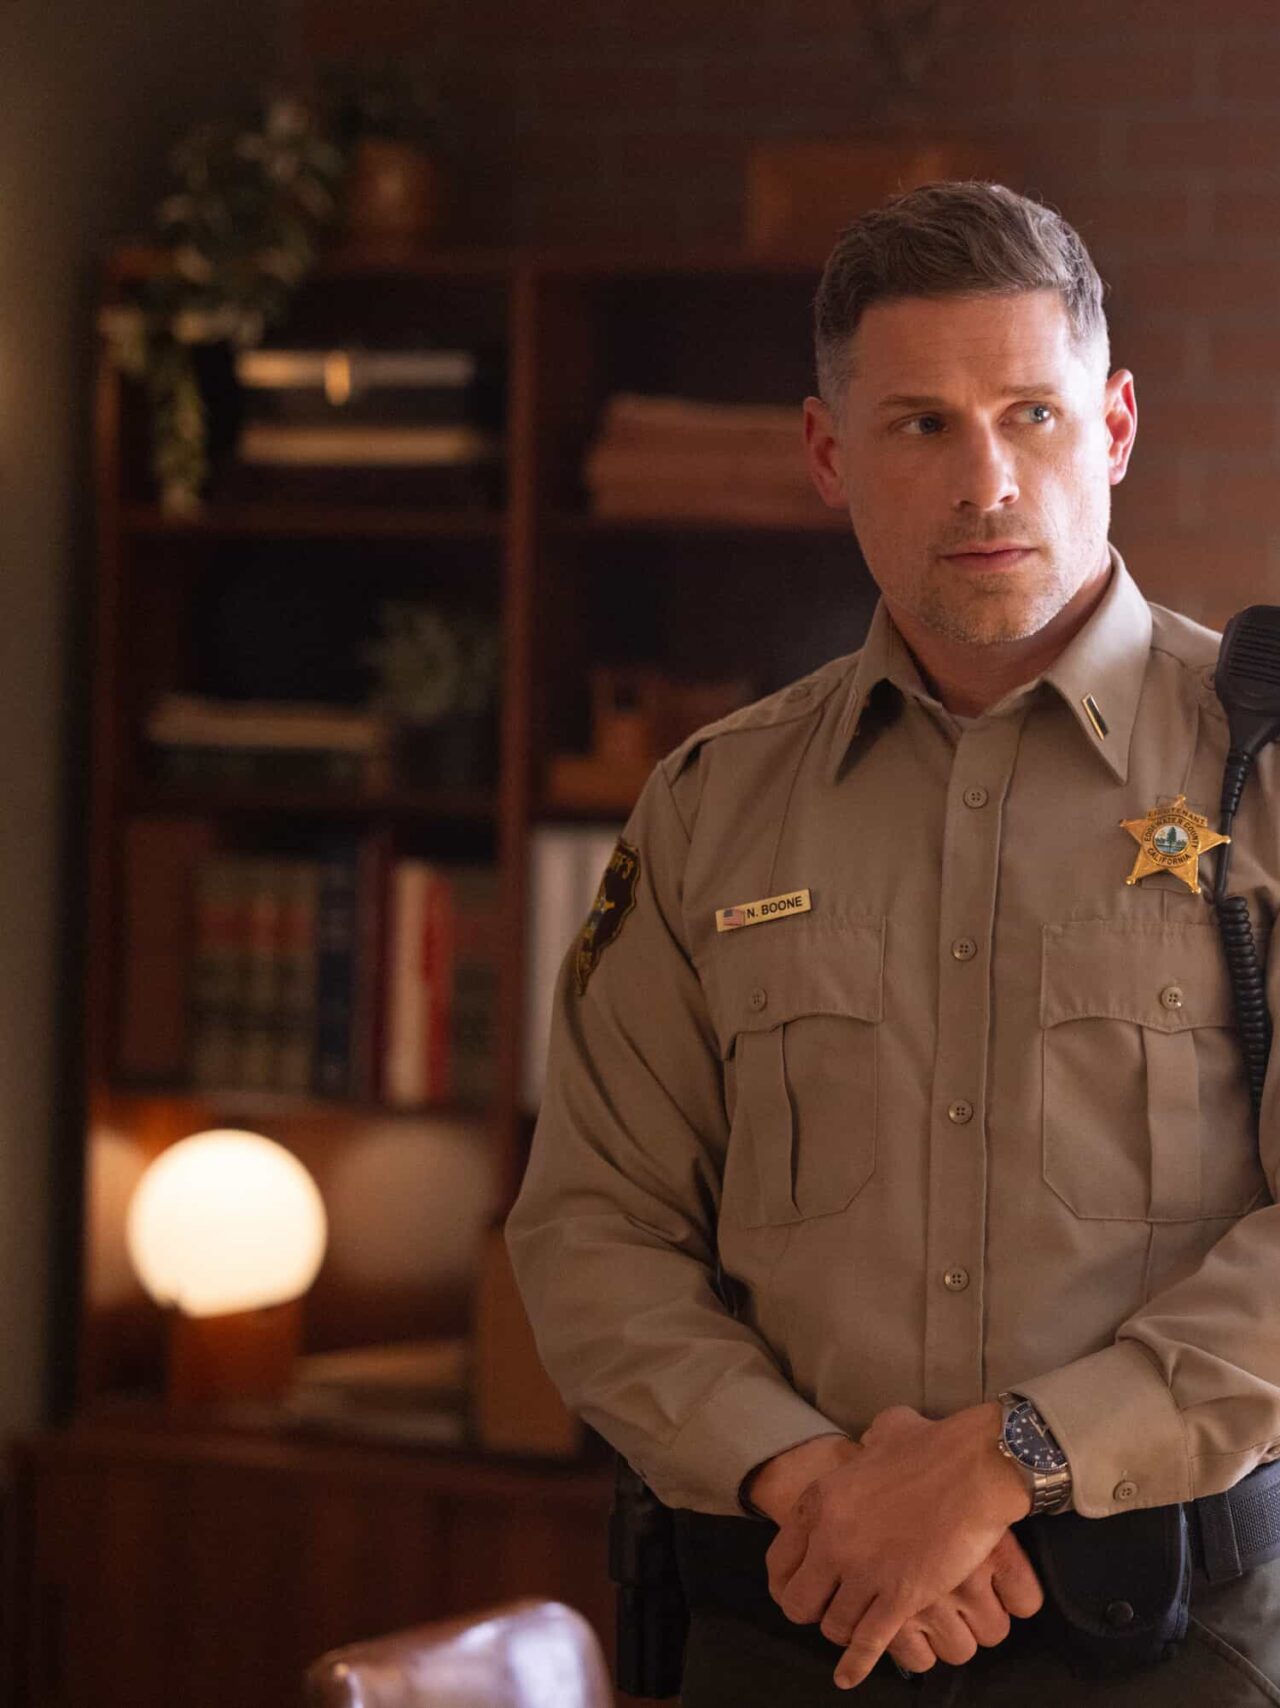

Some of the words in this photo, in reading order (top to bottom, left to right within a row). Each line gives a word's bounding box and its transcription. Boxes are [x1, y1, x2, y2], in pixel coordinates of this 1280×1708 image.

[1147, 848, 1192, 865] CALIFORNIA
[746, 908, 759, 918] N.
[761, 896, 803, 915] BOONE
